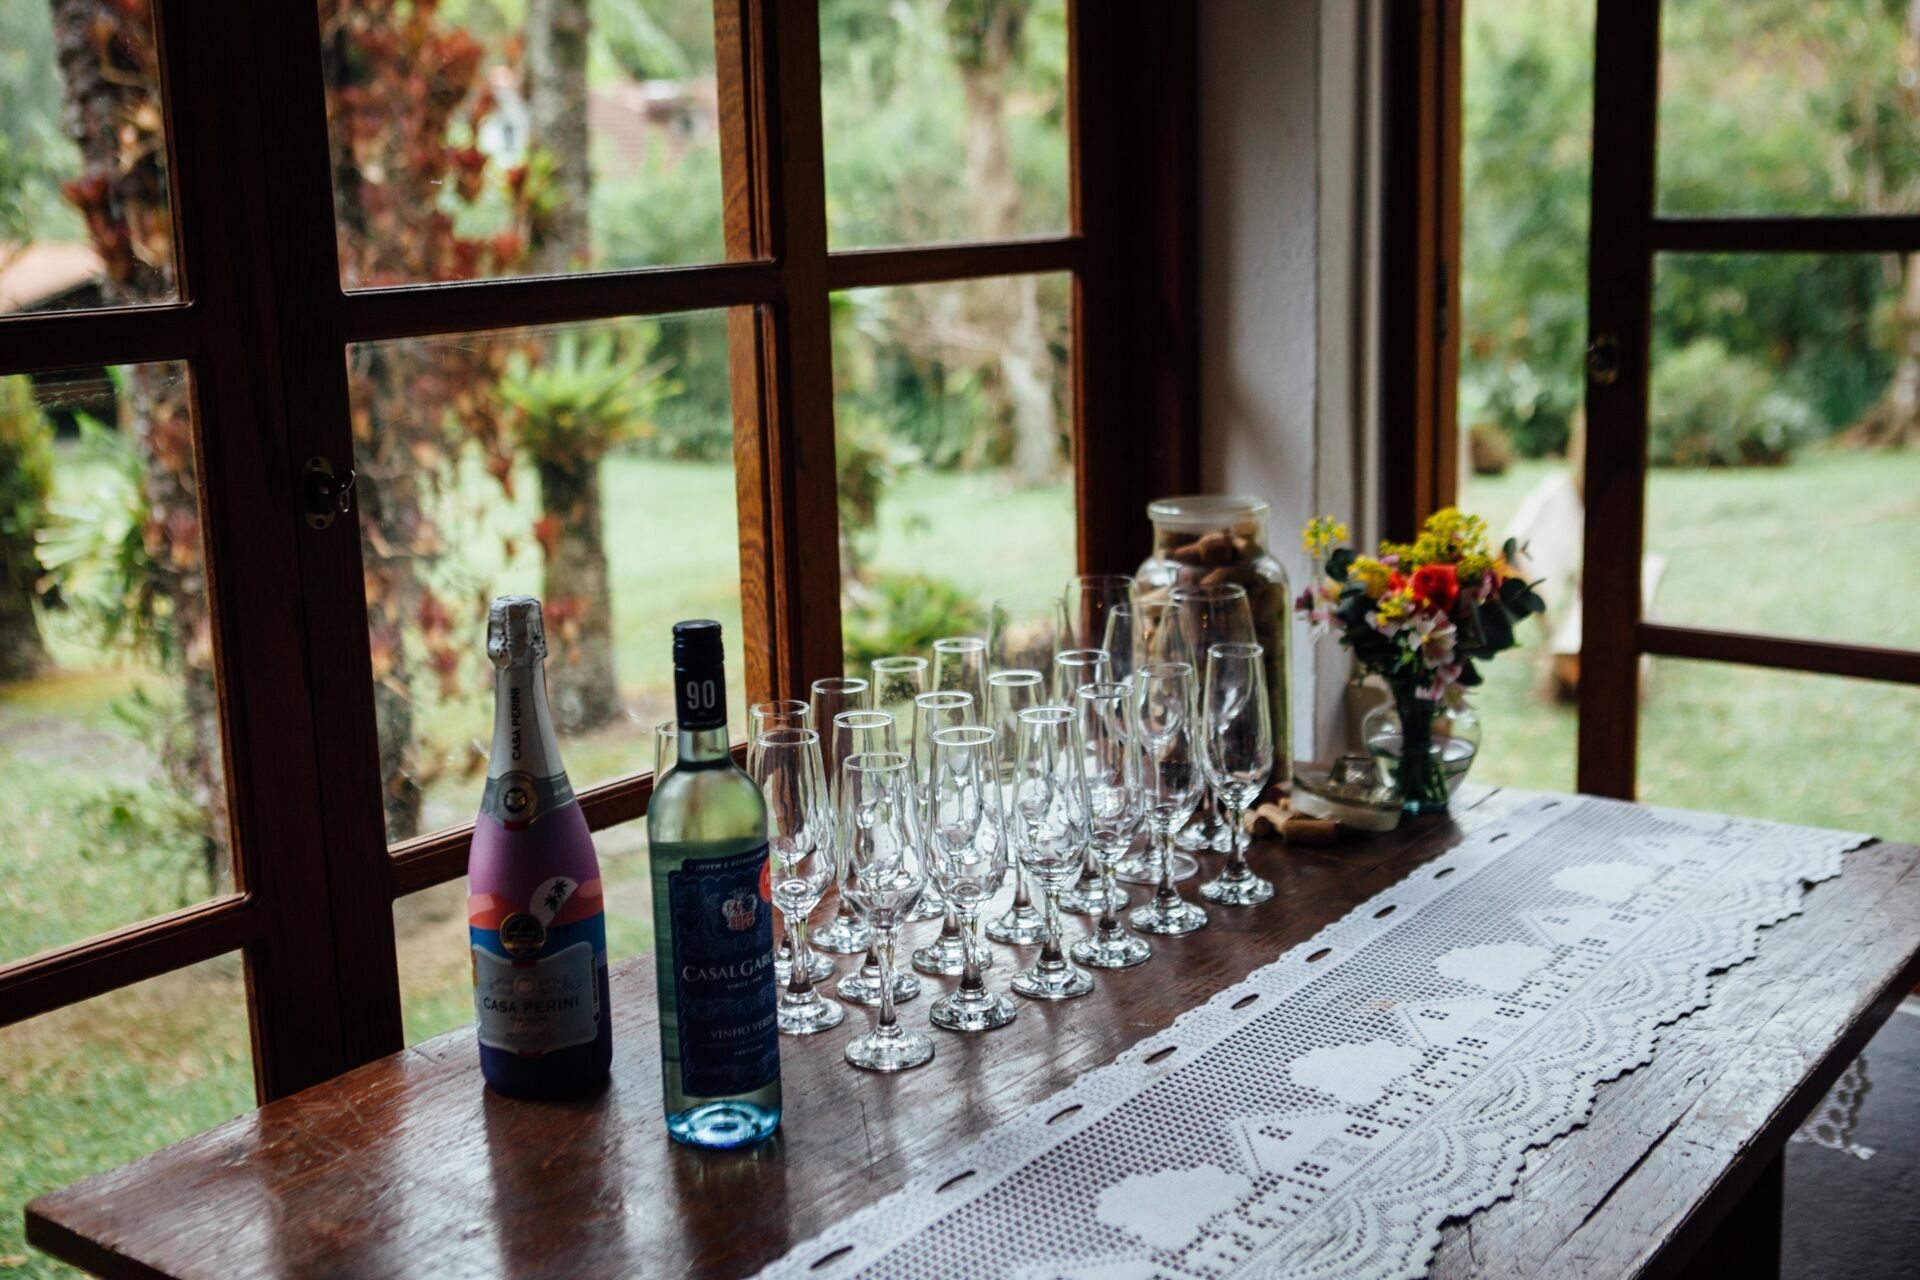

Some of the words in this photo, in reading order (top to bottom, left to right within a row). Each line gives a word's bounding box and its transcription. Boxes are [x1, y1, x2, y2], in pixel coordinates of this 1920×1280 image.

[511, 687, 521, 726] PERINI
[686, 679, 716, 710] 90
[512, 728, 521, 760] CASA
[682, 964, 738, 983] CASAL
[483, 997, 517, 1014] CASA
[523, 994, 579, 1014] PERINI
[709, 1025, 751, 1040] VINHO
